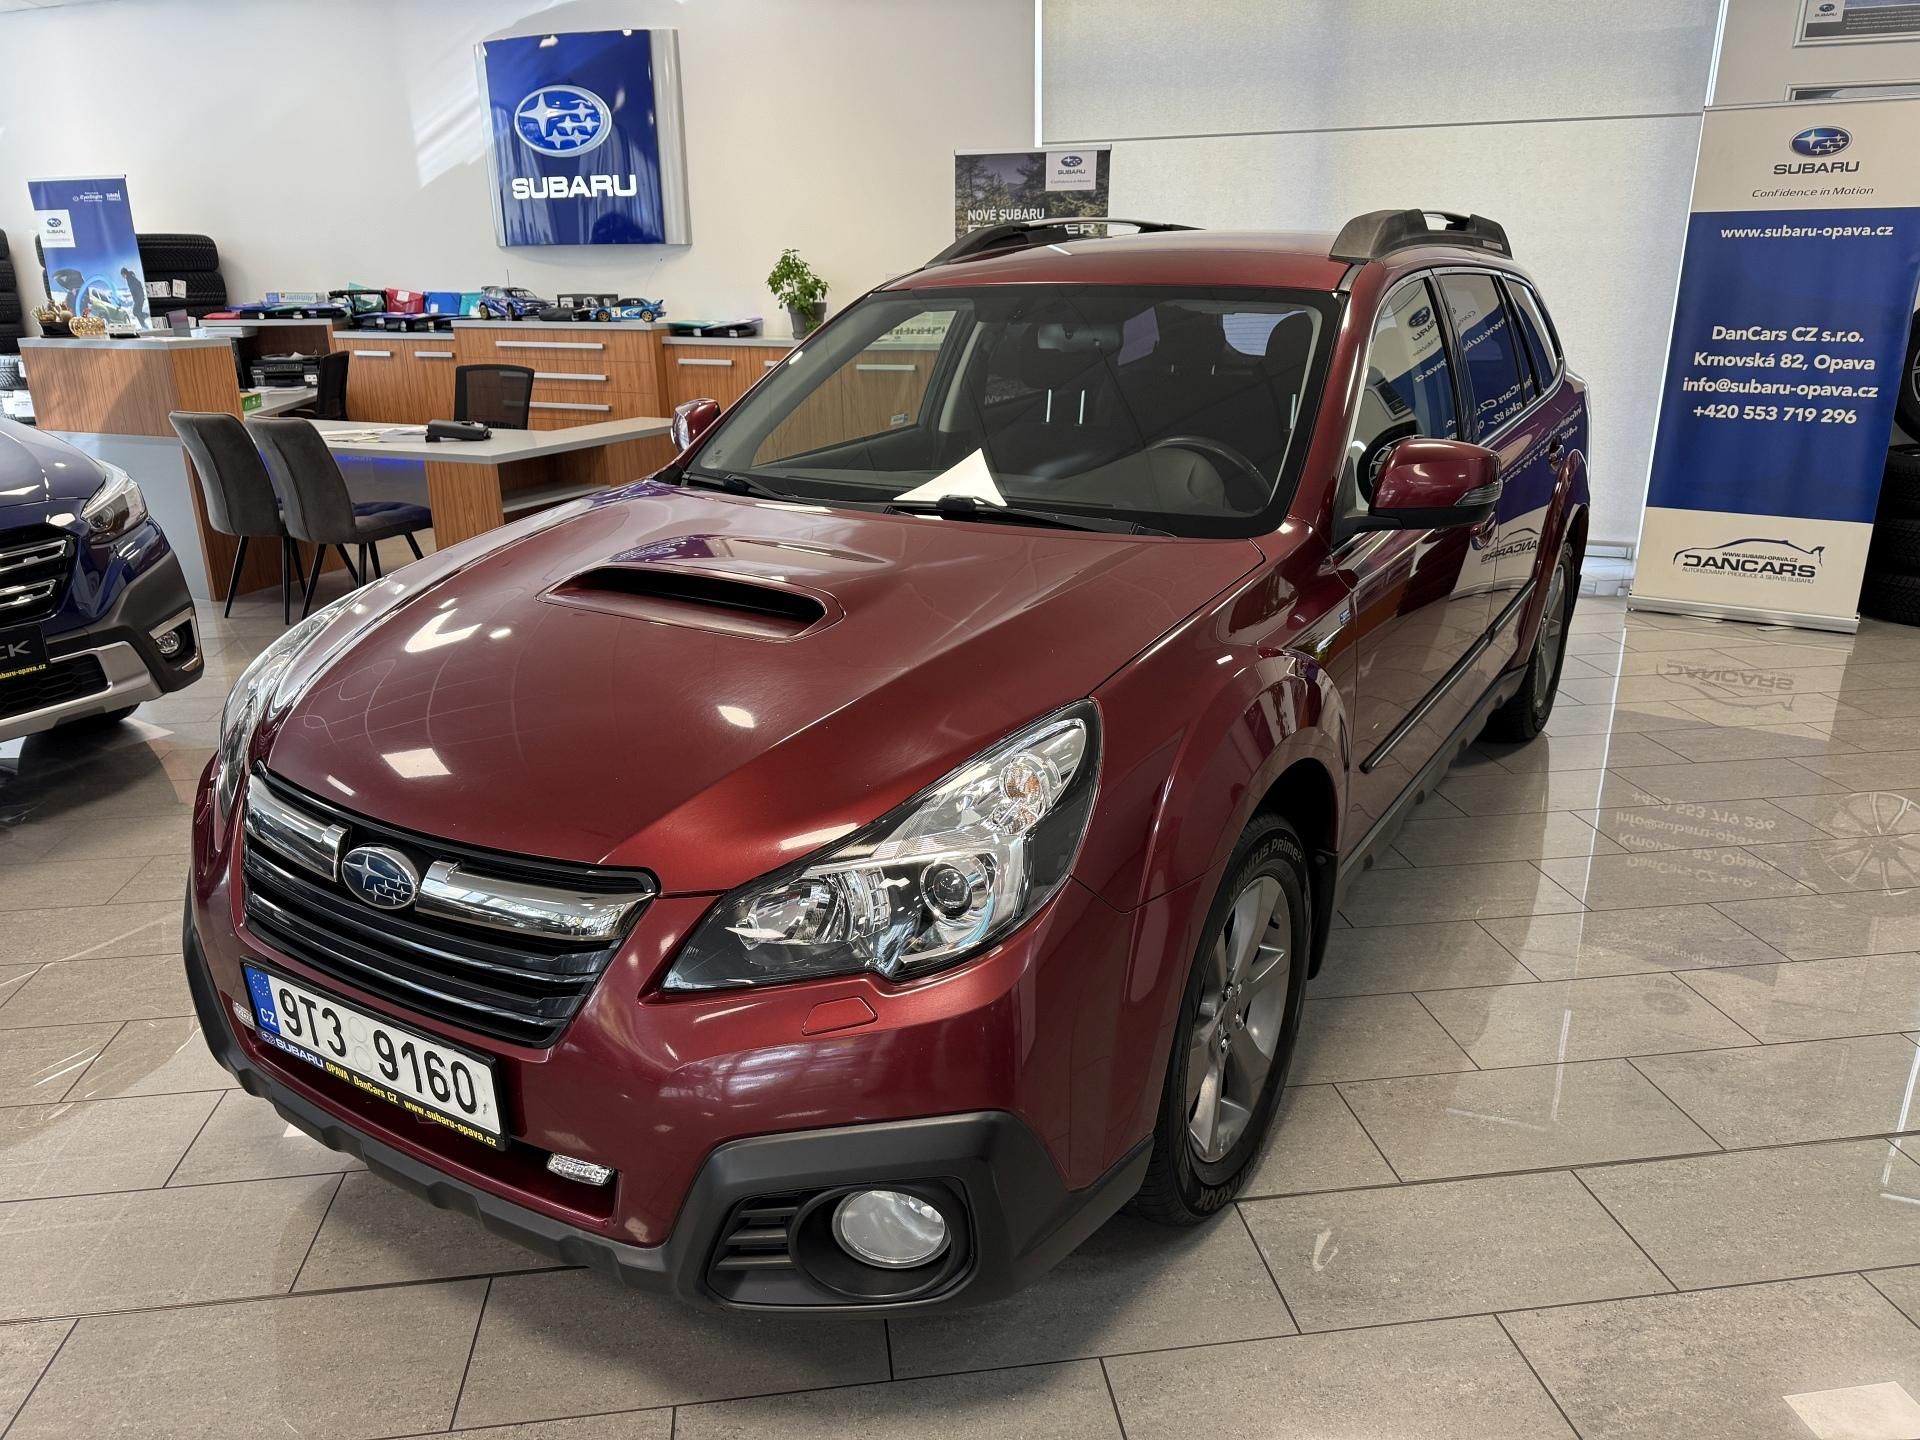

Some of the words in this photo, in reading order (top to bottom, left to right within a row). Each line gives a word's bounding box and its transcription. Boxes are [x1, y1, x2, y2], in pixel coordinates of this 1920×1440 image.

[1773, 161, 1860, 175] SUBARU
[511, 174, 638, 200] SUBARU
[1752, 187, 1817, 199] Confidence
[1820, 187, 1831, 196] in
[1833, 186, 1874, 196] Motion
[967, 206, 997, 221] NOVÉ
[998, 208, 1045, 220] SUBARU
[1720, 224, 1894, 240] www.subaru-opava.cz
[1711, 325, 1787, 341] DanCars
[1791, 326, 1818, 342] CZ
[1821, 330, 1865, 343] s.r.o.
[1694, 352, 1775, 368] Krnovská
[1780, 354, 1808, 371] 82,
[1814, 354, 1876, 374] Opava
[1683, 377, 1878, 399] info@subaru-opava.cz
[1693, 404, 1739, 418] +420
[1743, 405, 1778, 421] 553
[1783, 407, 1817, 422] 719
[1821, 408, 1857, 424] 296
[1683, 554, 1816, 578] DANCARS
[1722, 551, 1799, 563] WWW.SUBARU-OPAVA.CZ
[260, 1007, 279, 1027] CZ
[279, 987, 347, 1057] 9T3
[373, 1029, 478, 1115] 9160
[275, 1038, 324, 1068] SUBARU
[325, 1061, 350, 1081] OPAVA
[353, 1075, 386, 1098] DanCars
[387, 1091, 399, 1105] CZ
[403, 1100, 497, 1147] www.subaru-opava.cz
